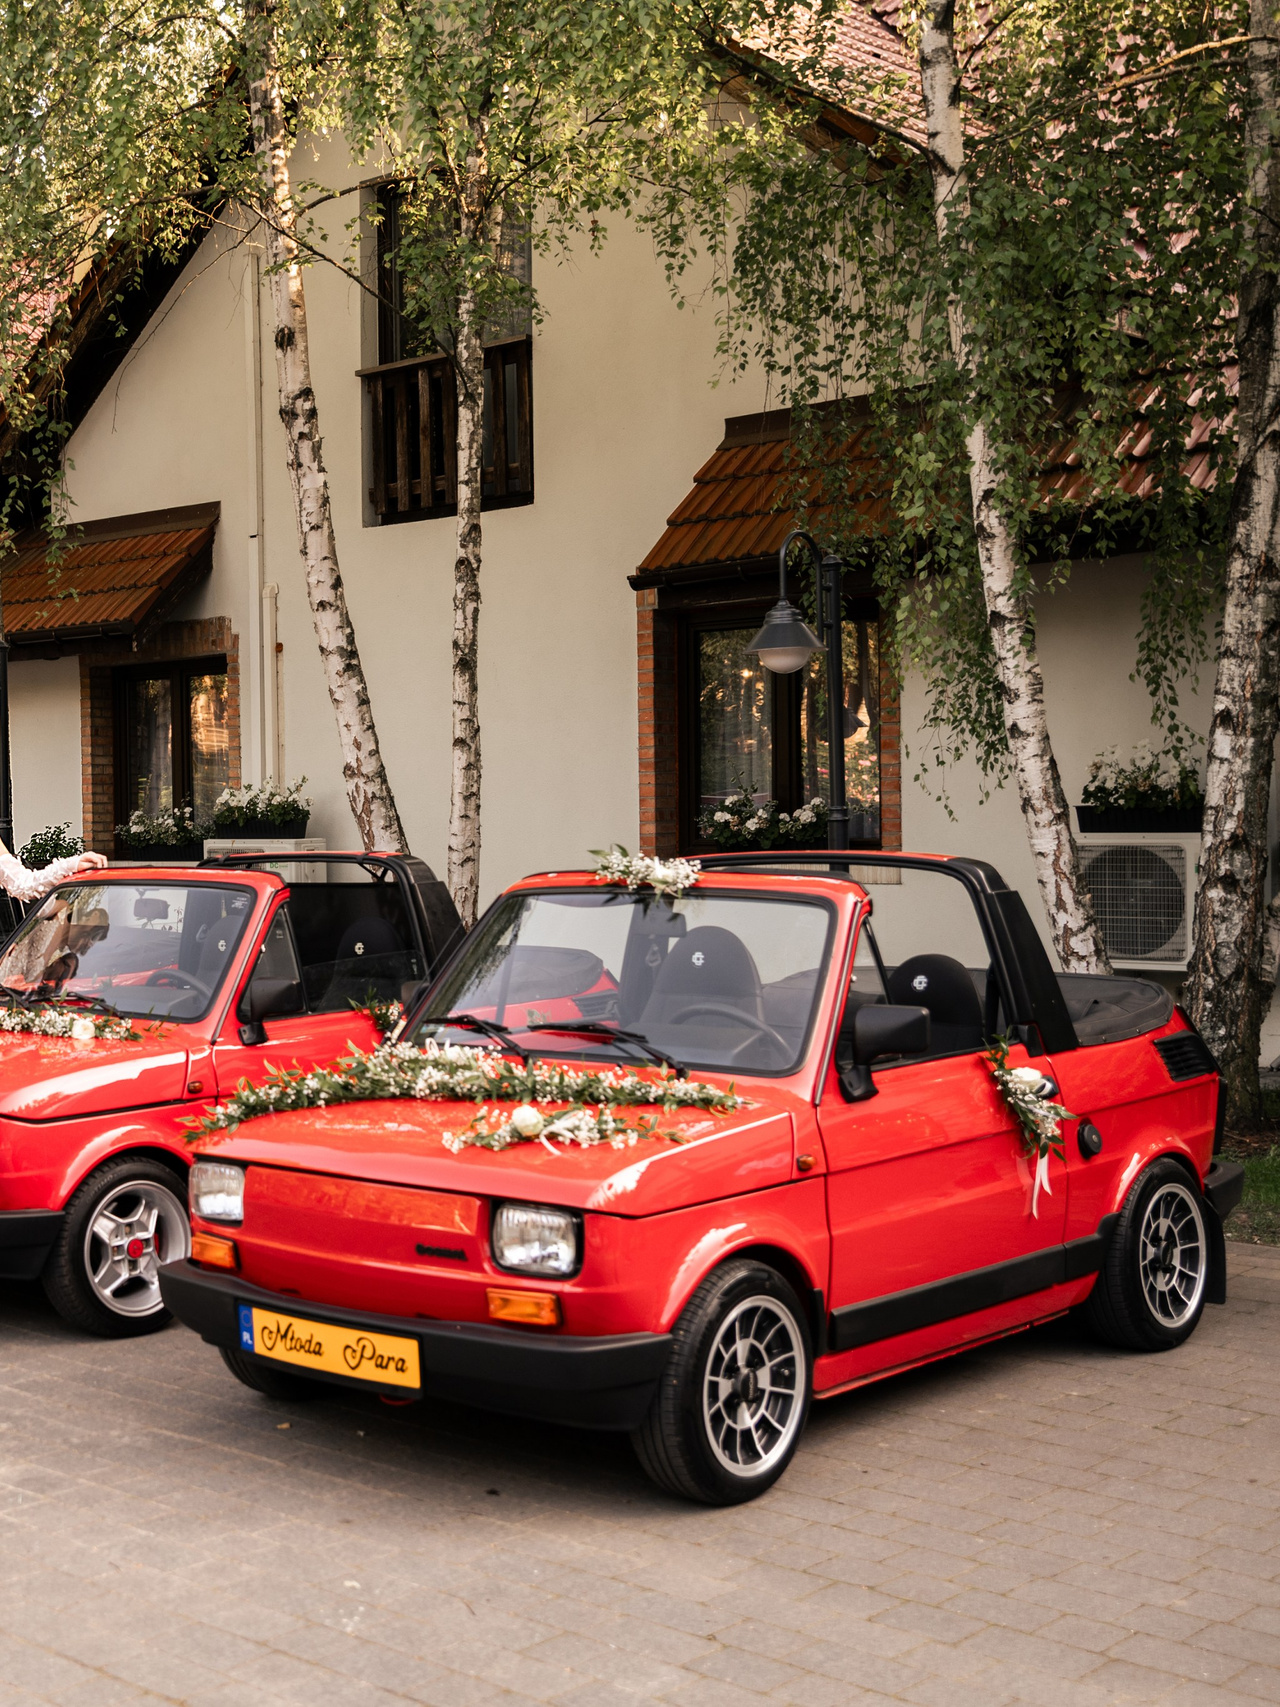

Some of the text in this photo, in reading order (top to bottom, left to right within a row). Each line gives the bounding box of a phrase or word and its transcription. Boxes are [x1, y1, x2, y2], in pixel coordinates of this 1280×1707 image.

[269, 861, 279, 869] DC
[242, 1330, 253, 1345] PL
[342, 1336, 409, 1374] Para
